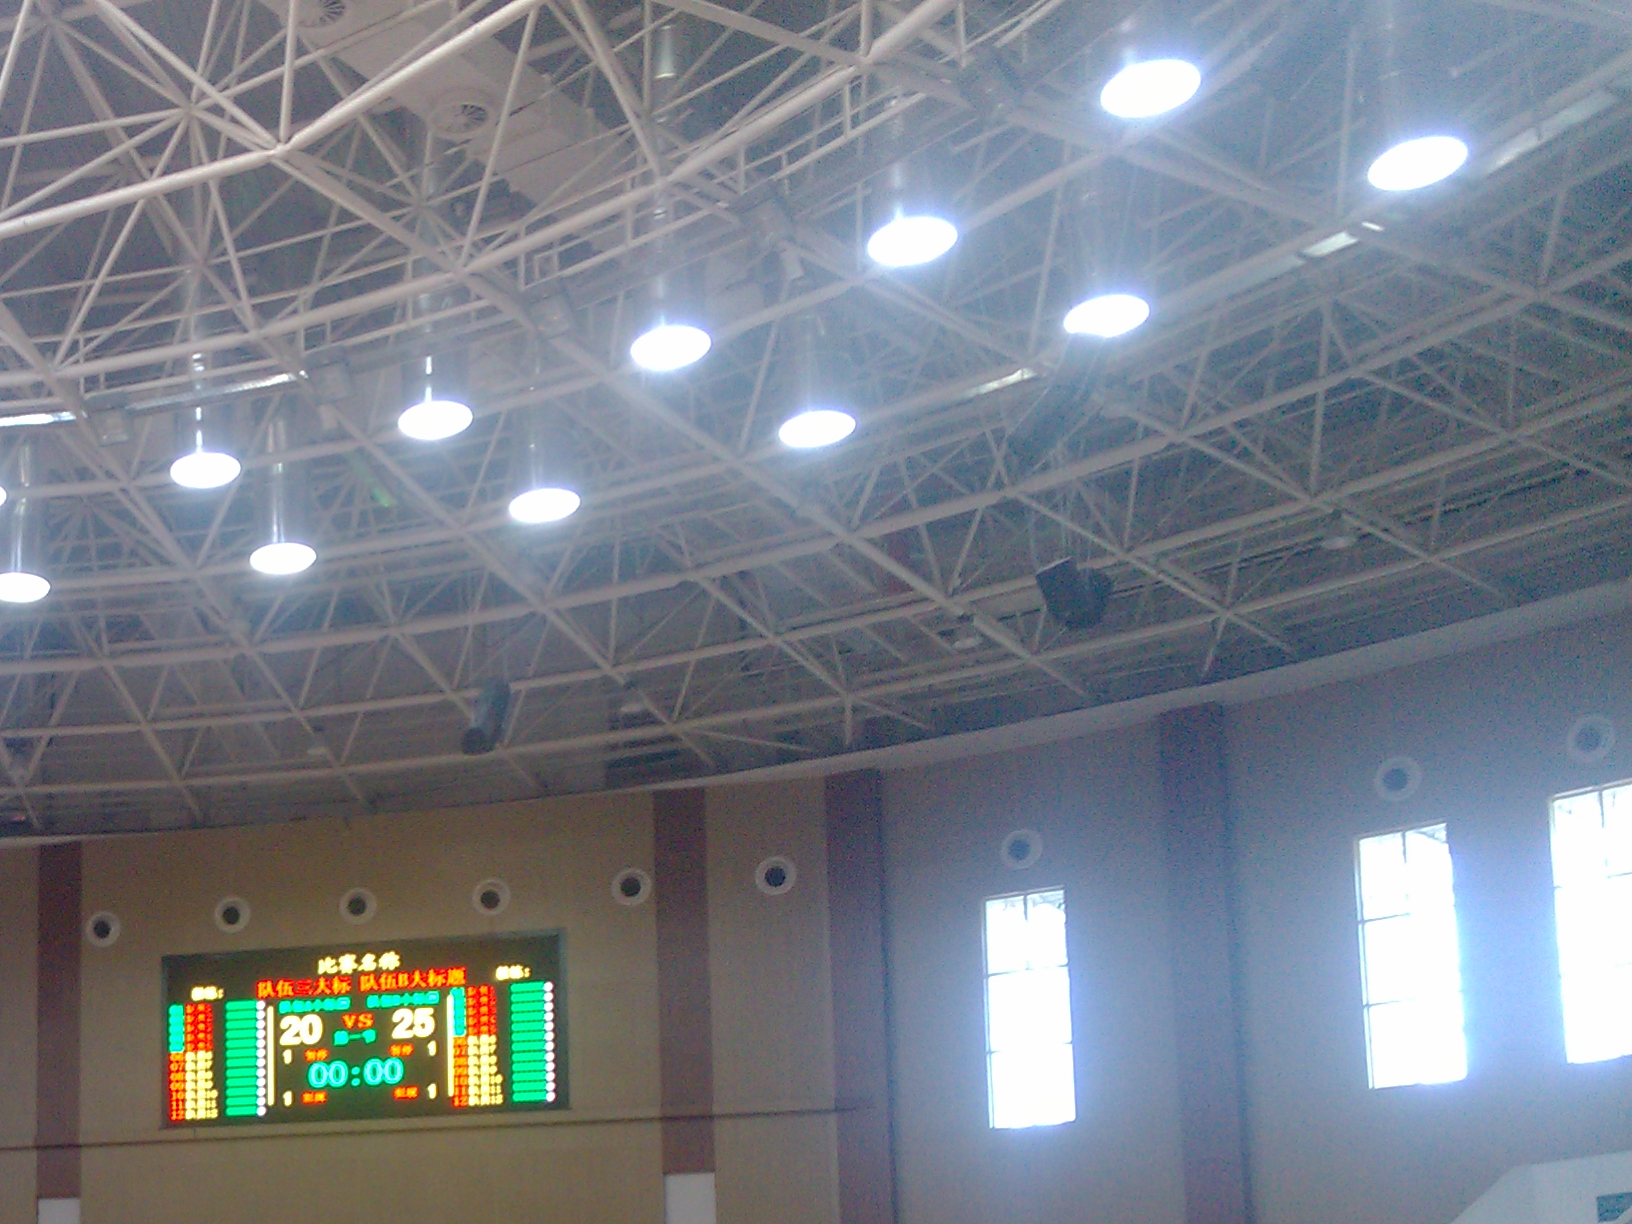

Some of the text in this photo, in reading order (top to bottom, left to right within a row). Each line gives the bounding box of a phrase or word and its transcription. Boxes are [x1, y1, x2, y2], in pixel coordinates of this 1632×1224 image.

[317, 951, 401, 975] 比赛名称
[279, 1014, 323, 1046] 20
[342, 1012, 374, 1029] VS
[391, 1007, 436, 1039] 25
[307, 1057, 404, 1088] 00:00
